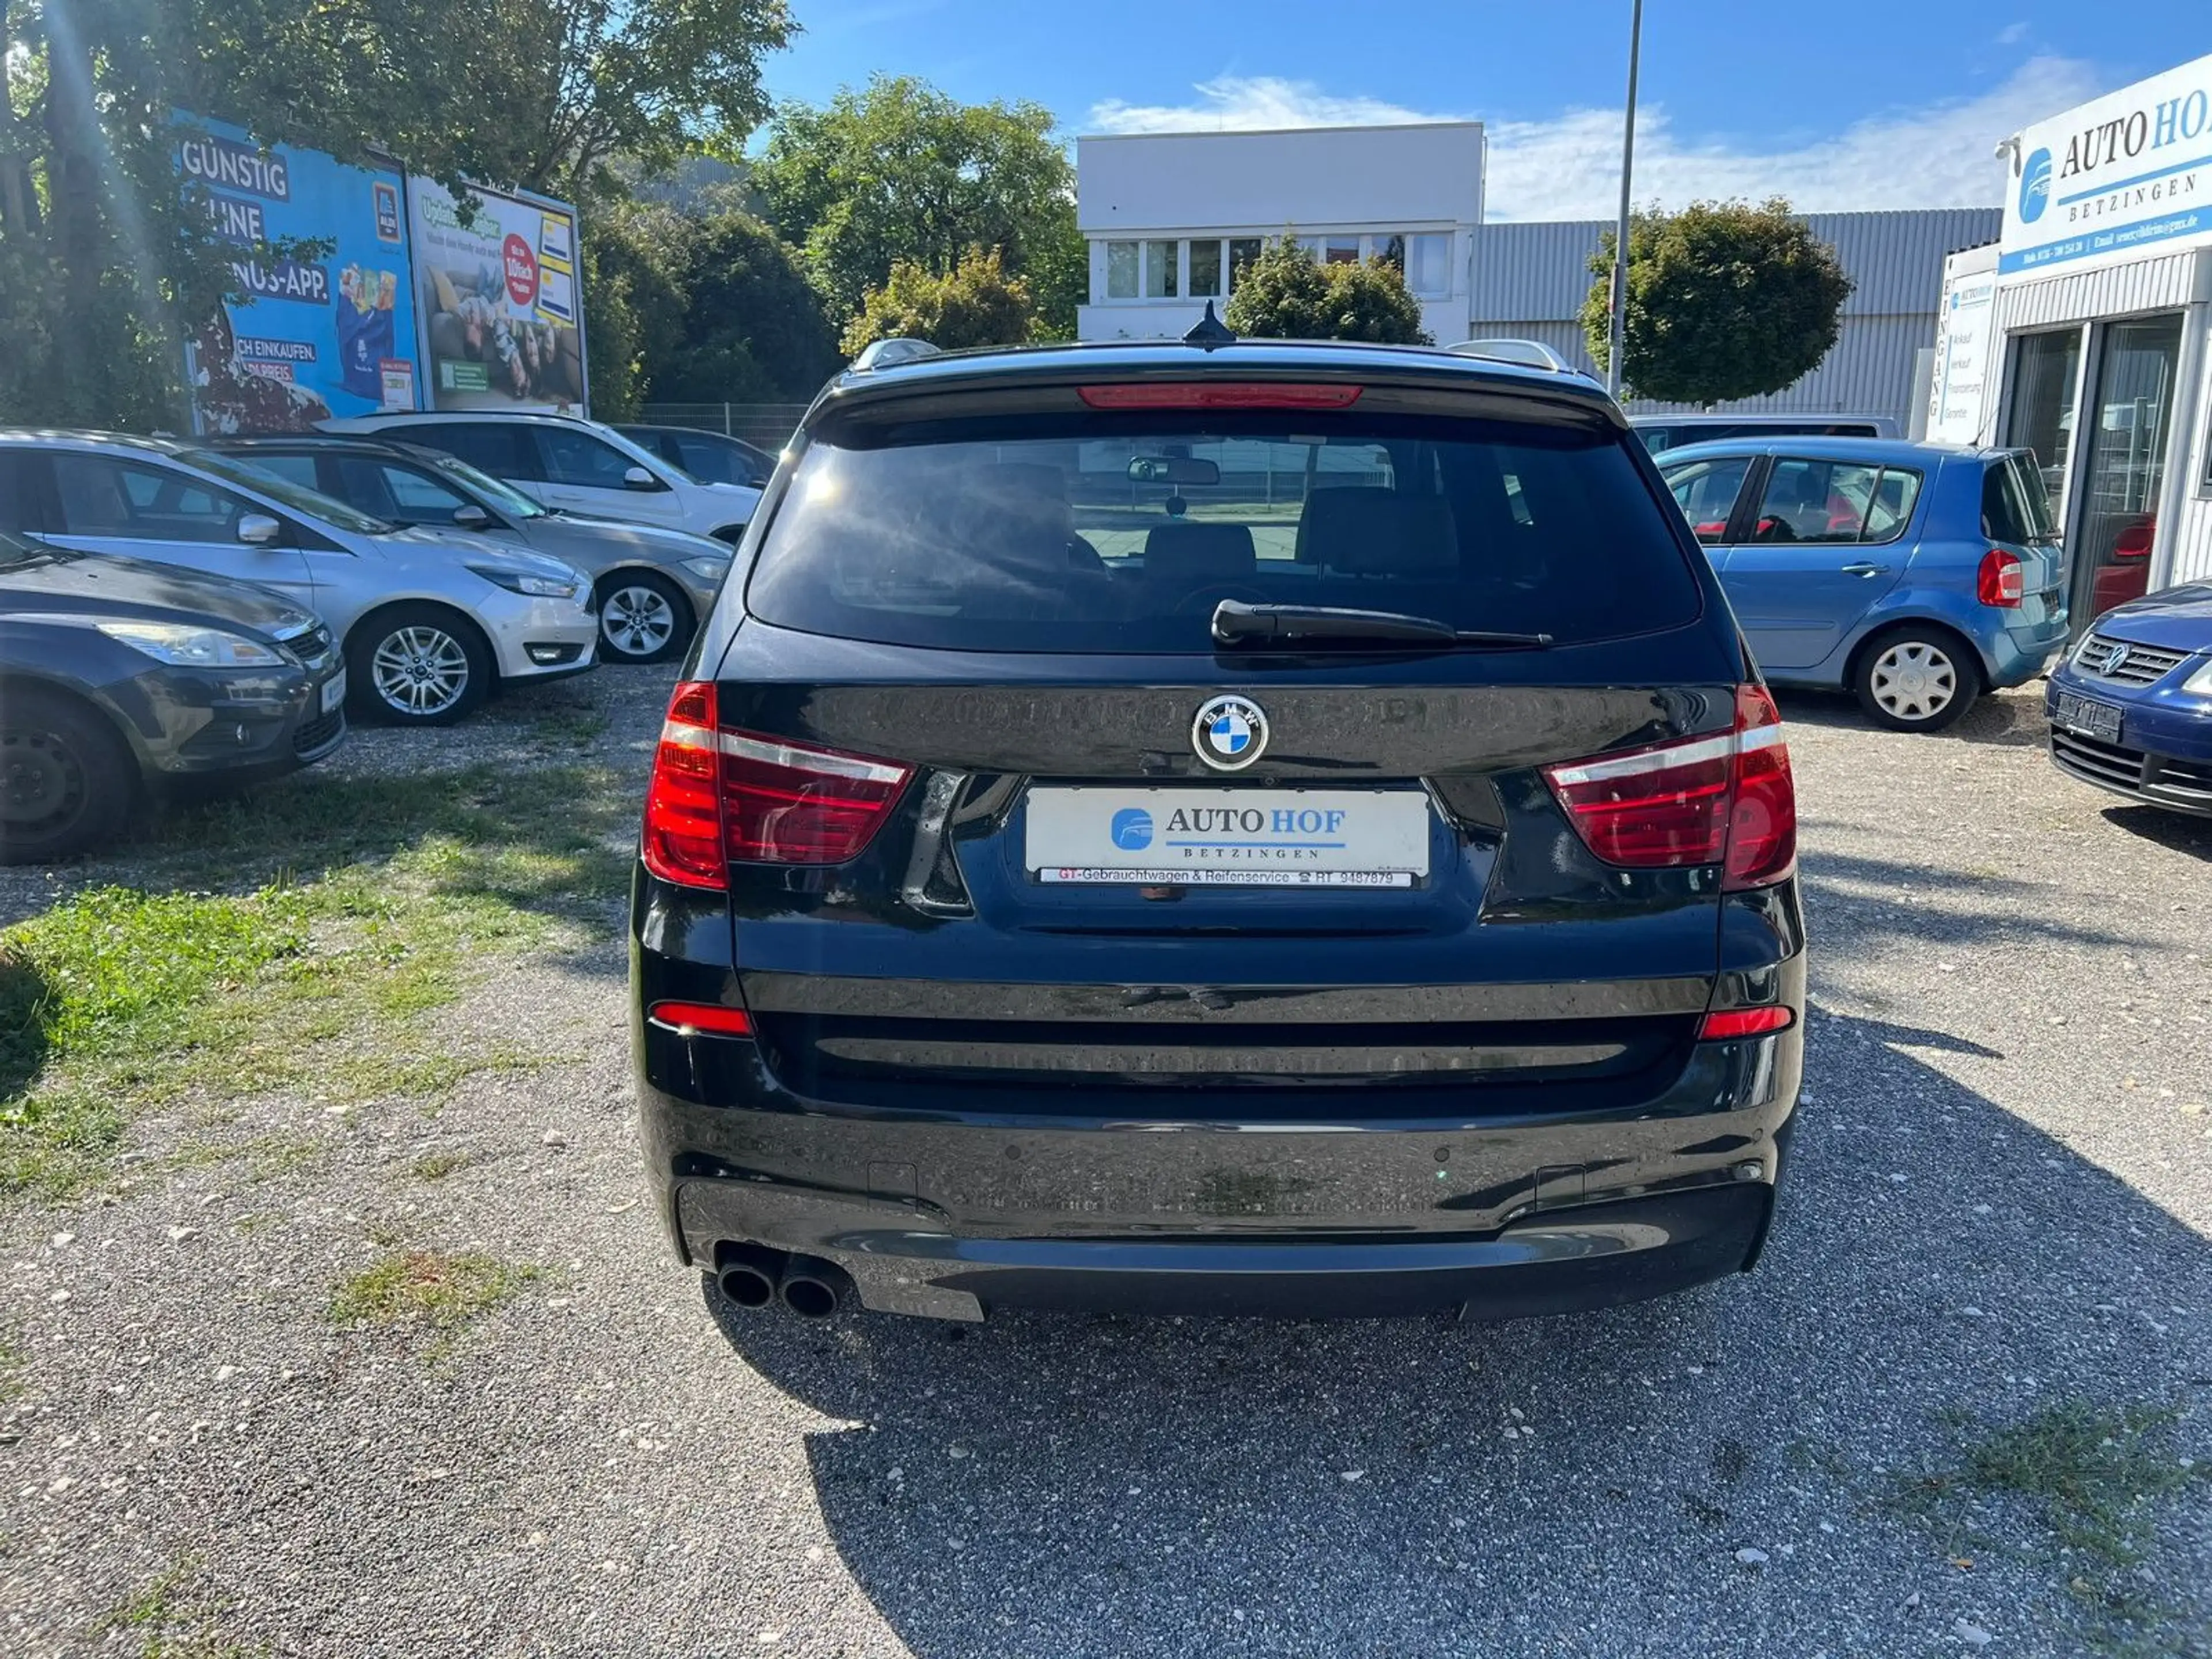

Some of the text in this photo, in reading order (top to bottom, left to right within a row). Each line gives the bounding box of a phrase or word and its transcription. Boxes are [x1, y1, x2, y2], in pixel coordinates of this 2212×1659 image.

[2060, 89, 2212, 179] AUTO HO
[182, 137, 286, 196] GÜNSTIG
[2069, 174, 2196, 222] BETZINGEN
[232, 260, 328, 300] NUS-APP.
[255, 341, 316, 361] EINKAUFEN.
[1930, 279, 1952, 416] EINGANG
[1204, 703, 1259, 728] BMW
[1166, 809, 1346, 834] AUTO HOF
[1184, 849, 1318, 858] BETZINGEN
[1058, 869, 1189, 882] GT-Gebrauchtwagen
[1192, 870, 1202, 881] &
[1205, 870, 1290, 882] Reifenservice
[1316, 872, 1334, 883] RT
